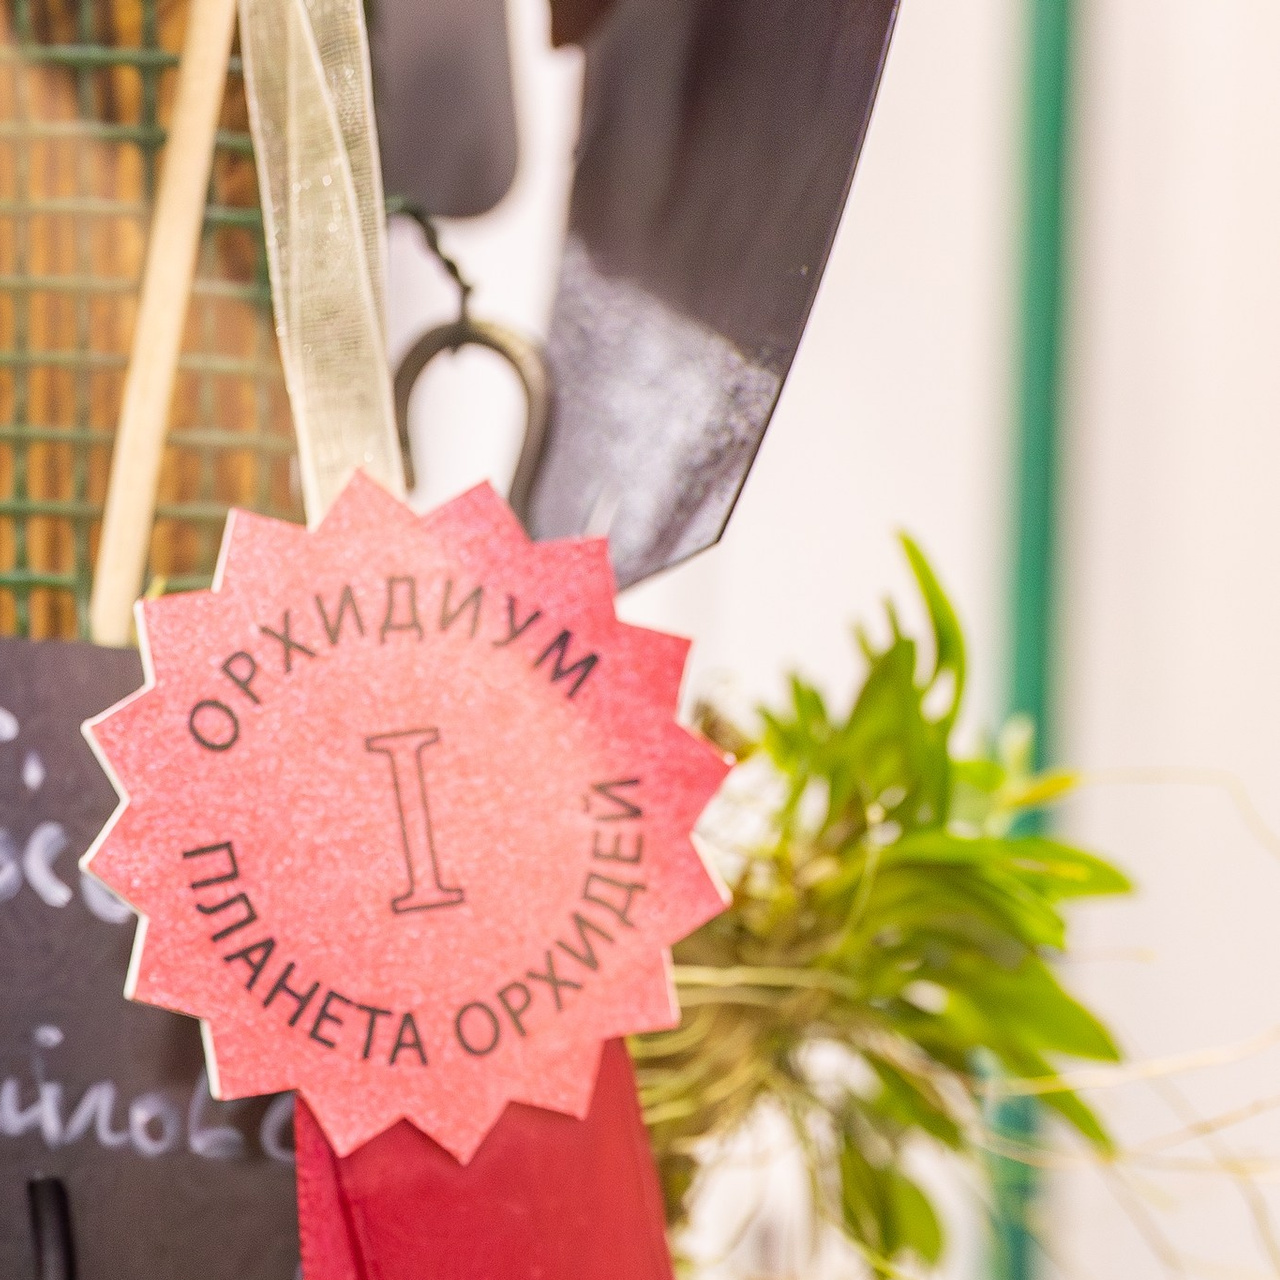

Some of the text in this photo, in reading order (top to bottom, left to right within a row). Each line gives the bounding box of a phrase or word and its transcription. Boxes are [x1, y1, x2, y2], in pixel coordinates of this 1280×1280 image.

[187, 576, 600, 753] ОРХИДИУМ
[365, 727, 465, 914] I
[182, 777, 648, 1067] ПЛАНЕТА ОРХИДЕЙ
